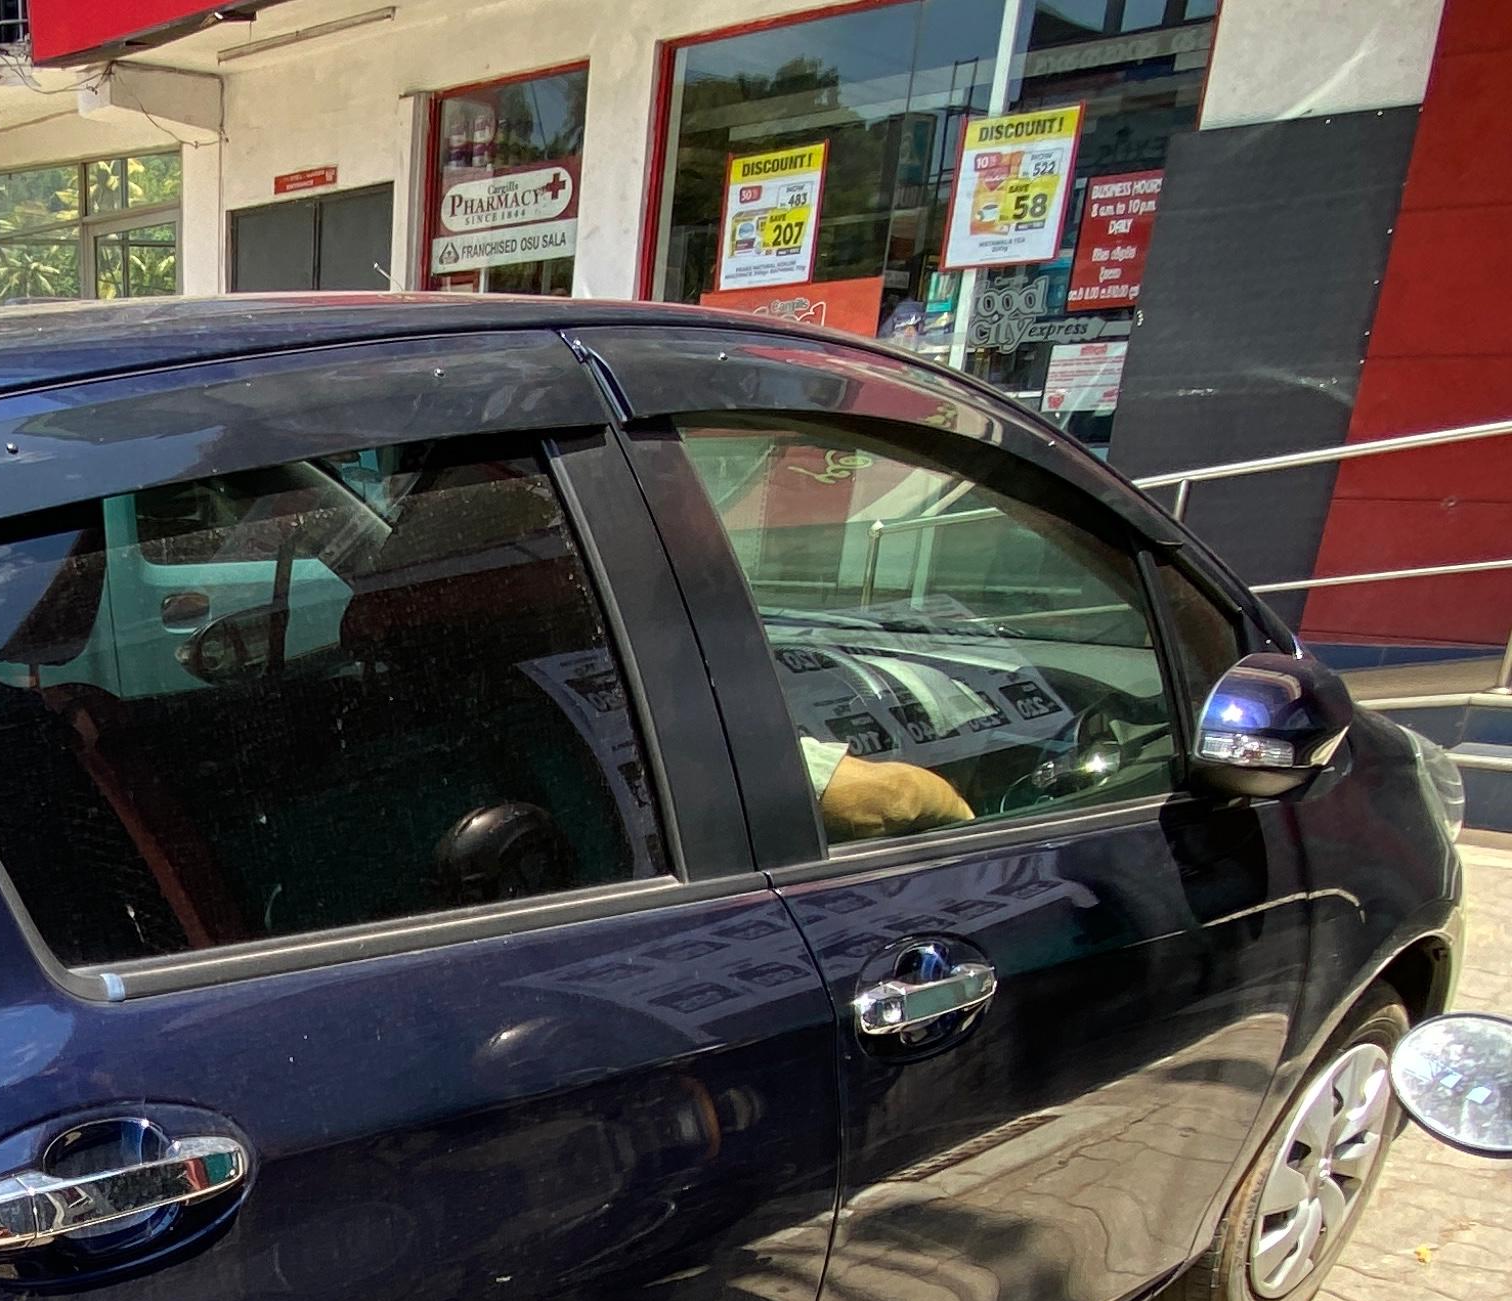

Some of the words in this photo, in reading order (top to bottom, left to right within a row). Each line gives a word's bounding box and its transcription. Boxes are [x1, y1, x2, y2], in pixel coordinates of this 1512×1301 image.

[978, 116, 1064, 142] DISCOUNT!
[741, 153, 813, 178] DISCOUNT!
[1032, 161, 1055, 177] 522
[488, 181, 519, 195] Cargills
[1091, 182, 1132, 200] BUSINESS
[449, 188, 541, 218] PHARMACY
[788, 192, 808, 207] 483
[1012, 193, 1048, 221] 58
[1128, 199, 1141, 214] 10
[465, 215, 498, 226] SINCE
[772, 221, 804, 248] 207
[461, 239, 518, 260] FRANCHISED
[520, 236, 541, 252] OSU
[542, 232, 567, 249] SALA
[1028, 322, 1088, 341] express
